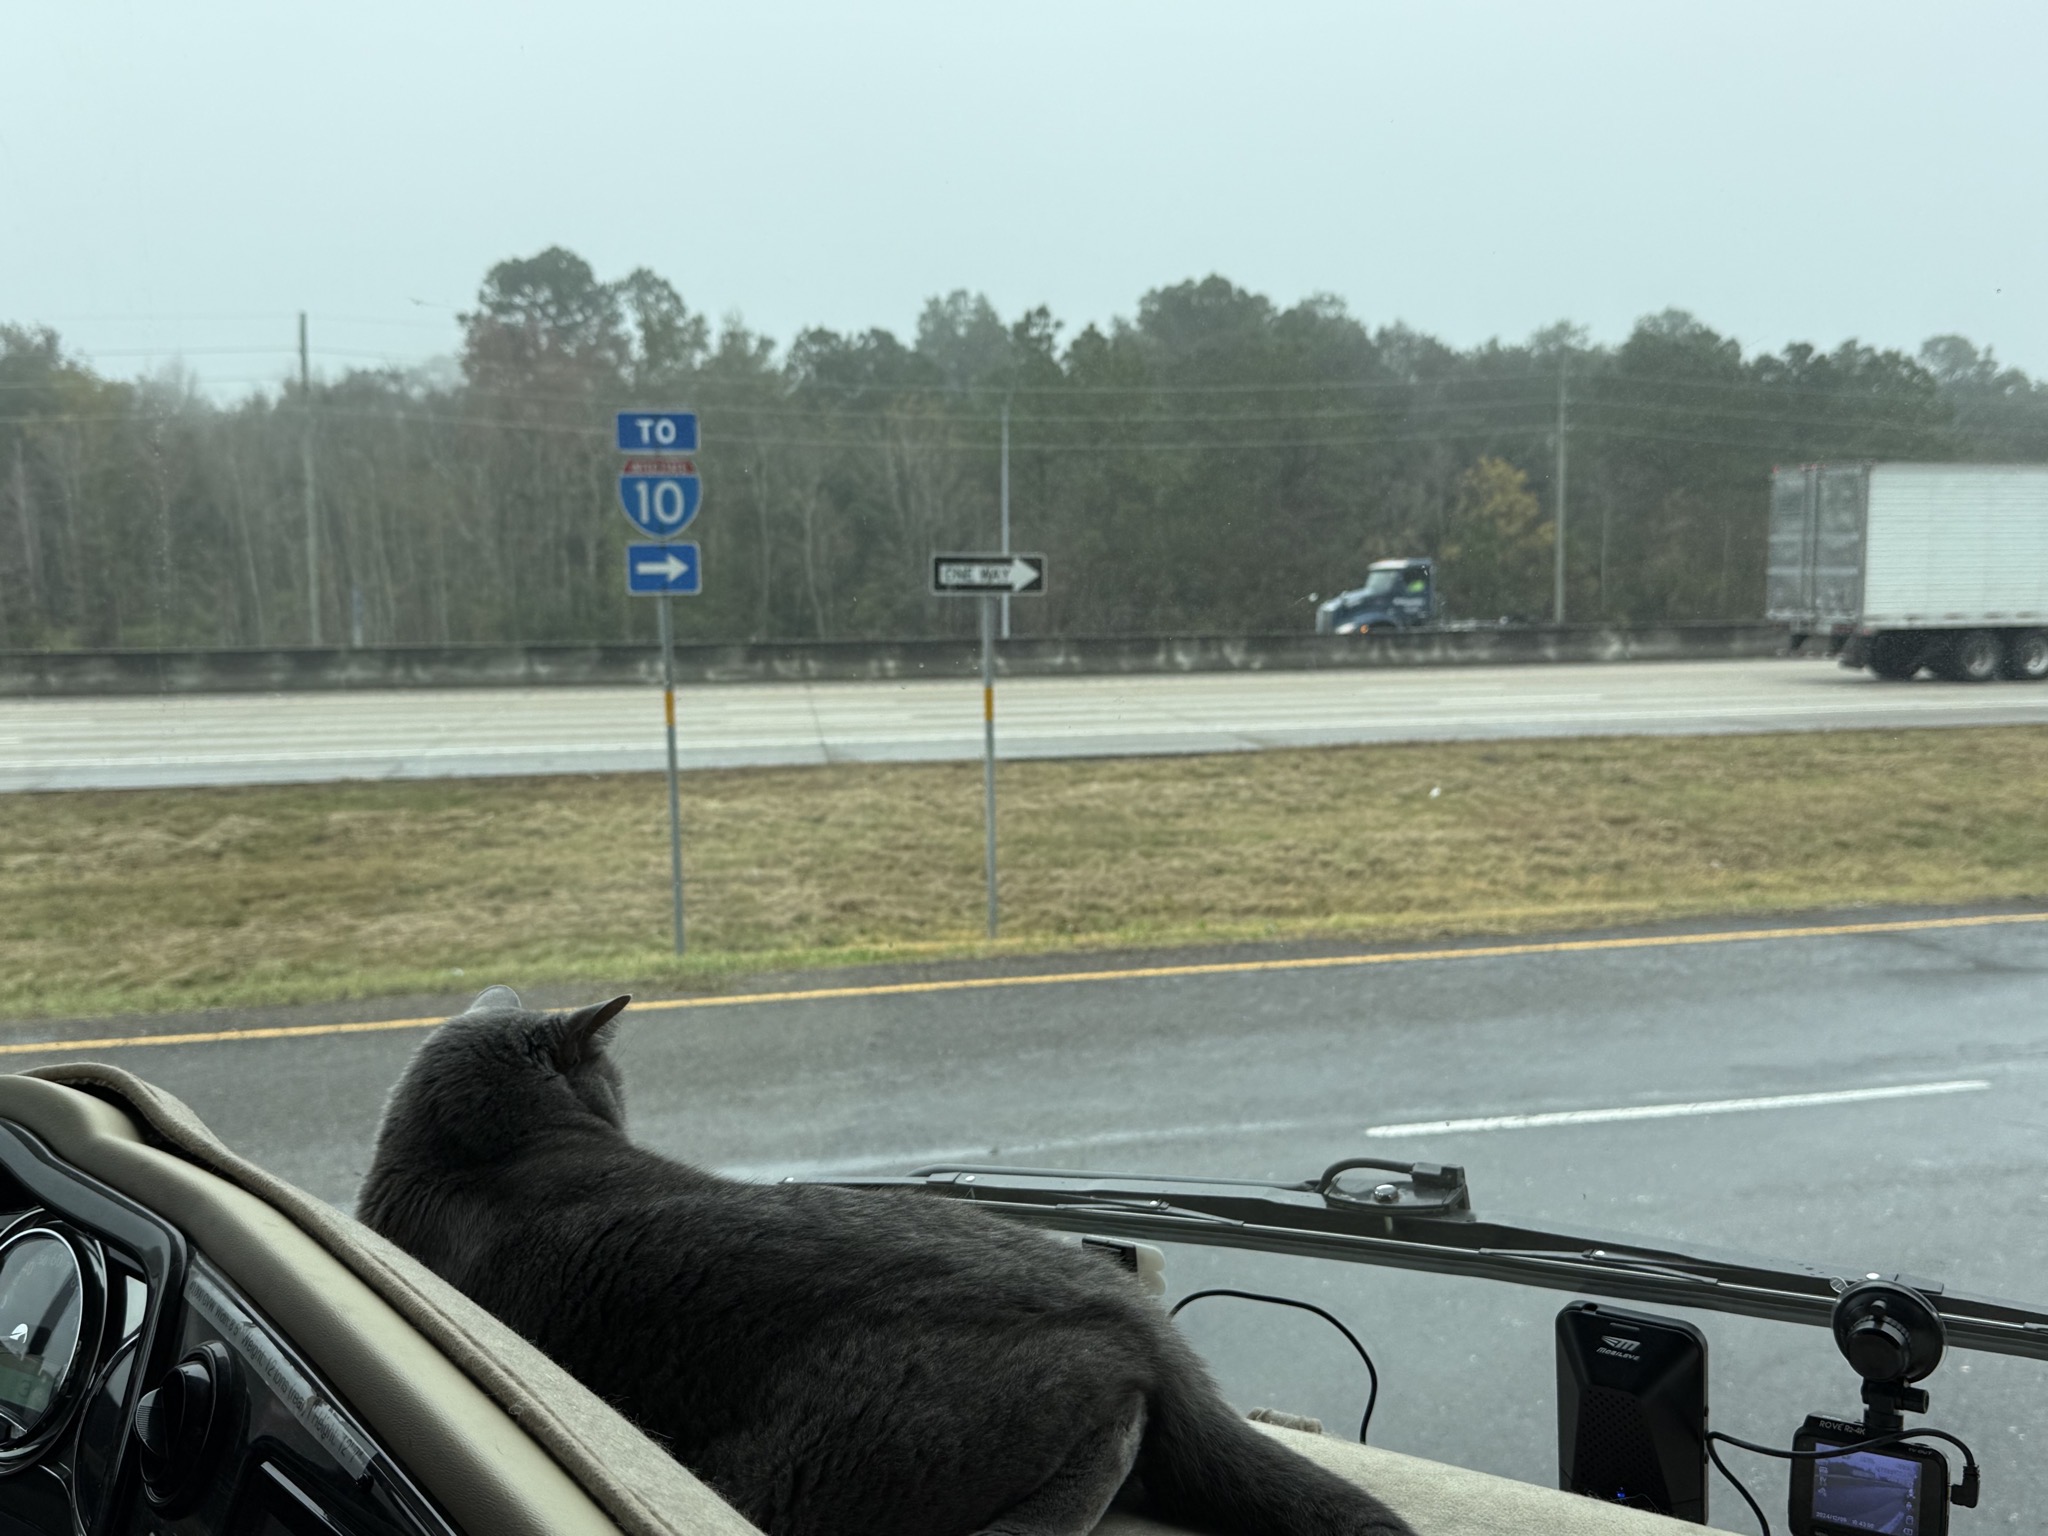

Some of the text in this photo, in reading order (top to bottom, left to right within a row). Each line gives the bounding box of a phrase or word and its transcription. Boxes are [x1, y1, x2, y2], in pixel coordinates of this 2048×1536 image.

[635, 418, 676, 444] TO
[635, 480, 685, 525] 10
[980, 567, 1010, 580] WAY
[273, 1367, 290, 1392] tons
[1819, 1419, 1843, 1431] ROVE
